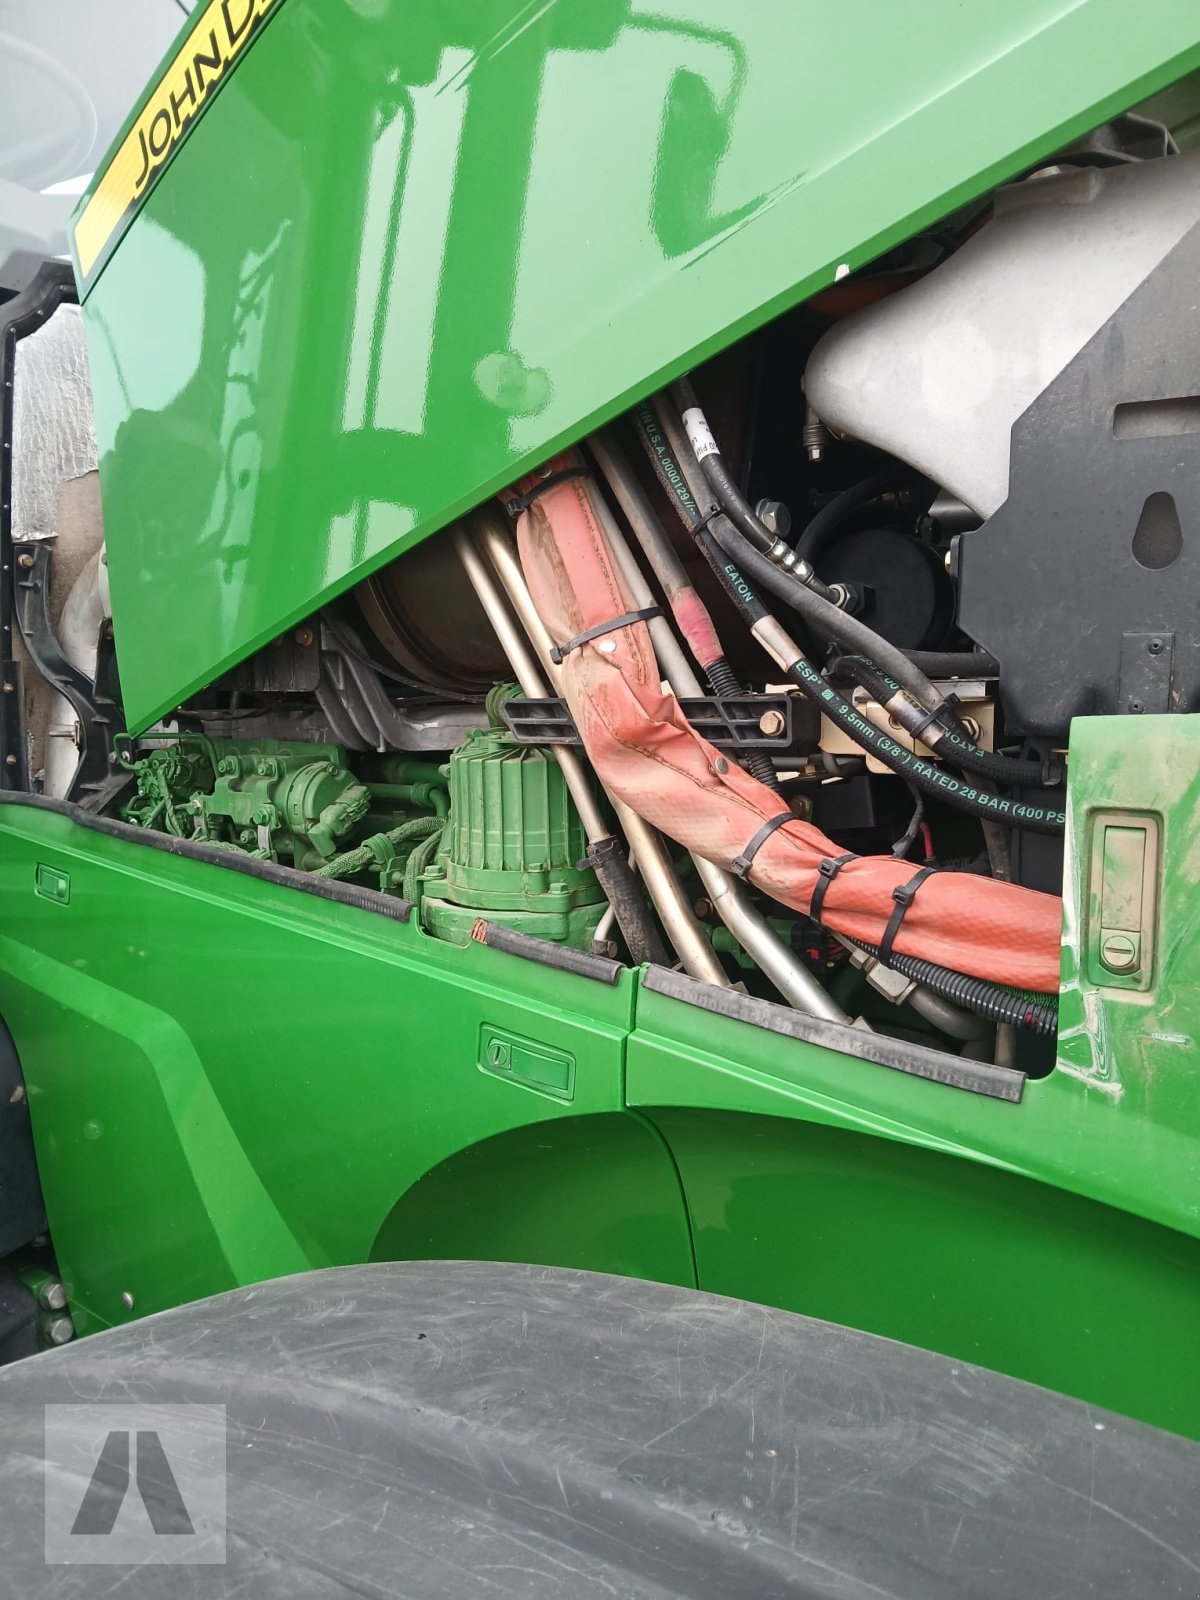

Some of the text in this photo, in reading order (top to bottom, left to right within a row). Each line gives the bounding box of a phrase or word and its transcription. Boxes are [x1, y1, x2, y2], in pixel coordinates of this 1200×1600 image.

[135, 0, 266, 189] JOHN D
[724, 564, 754, 602] EATON
[838, 705, 875, 739] 9.5mm
[877, 736, 911, 764] (3/8")
[913, 761, 959, 791] RATED
[958, 786, 976, 800] 28
[977, 793, 1010, 812] BAR
[1012, 803, 1044, 820] (400
